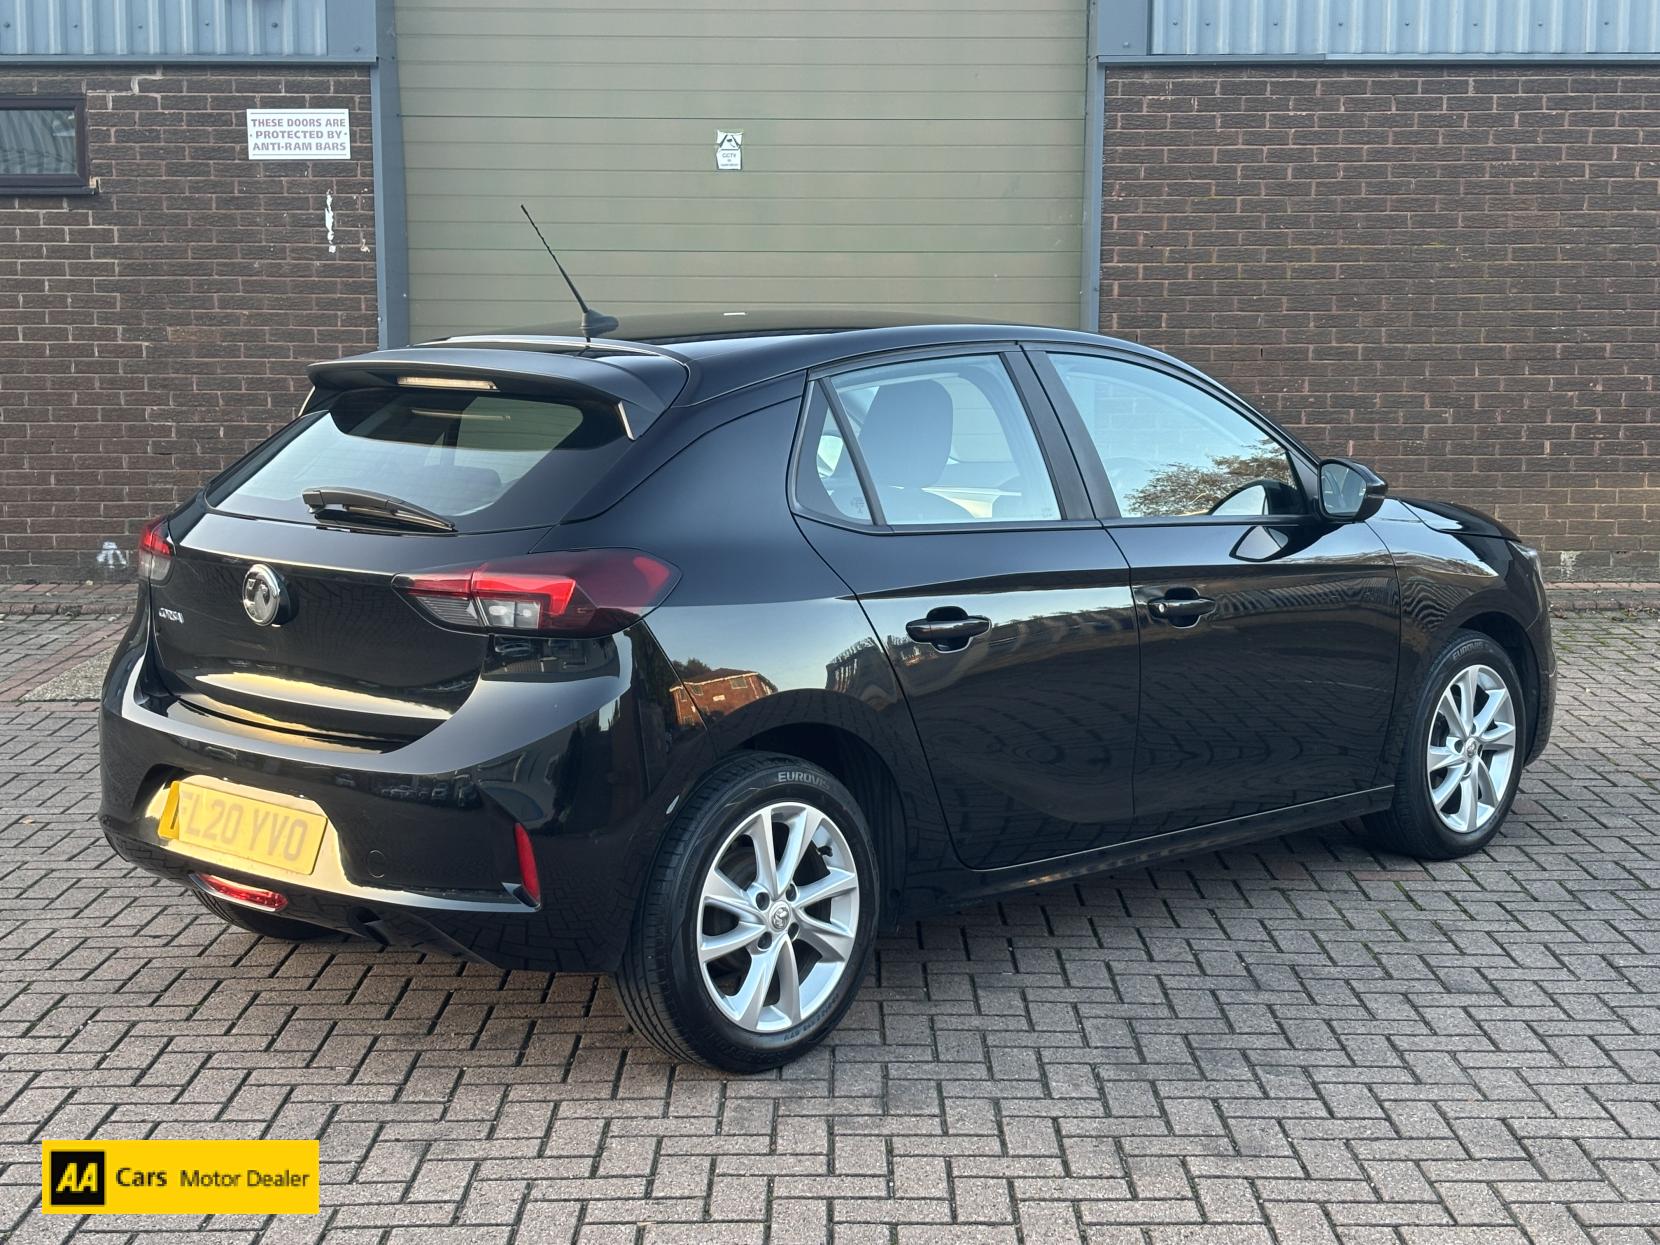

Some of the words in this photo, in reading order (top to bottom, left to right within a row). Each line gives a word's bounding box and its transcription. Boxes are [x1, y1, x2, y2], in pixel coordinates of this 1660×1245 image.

[251, 118, 284, 128] THESE
[287, 118, 322, 128] DOORS
[325, 118, 346, 128] ARE
[255, 130, 324, 139] PROTECTED
[327, 130, 342, 139] BY
[253, 142, 312, 151] ANTI-RAM
[315, 142, 346, 151] BARS
[249, 807, 309, 862] YVO
